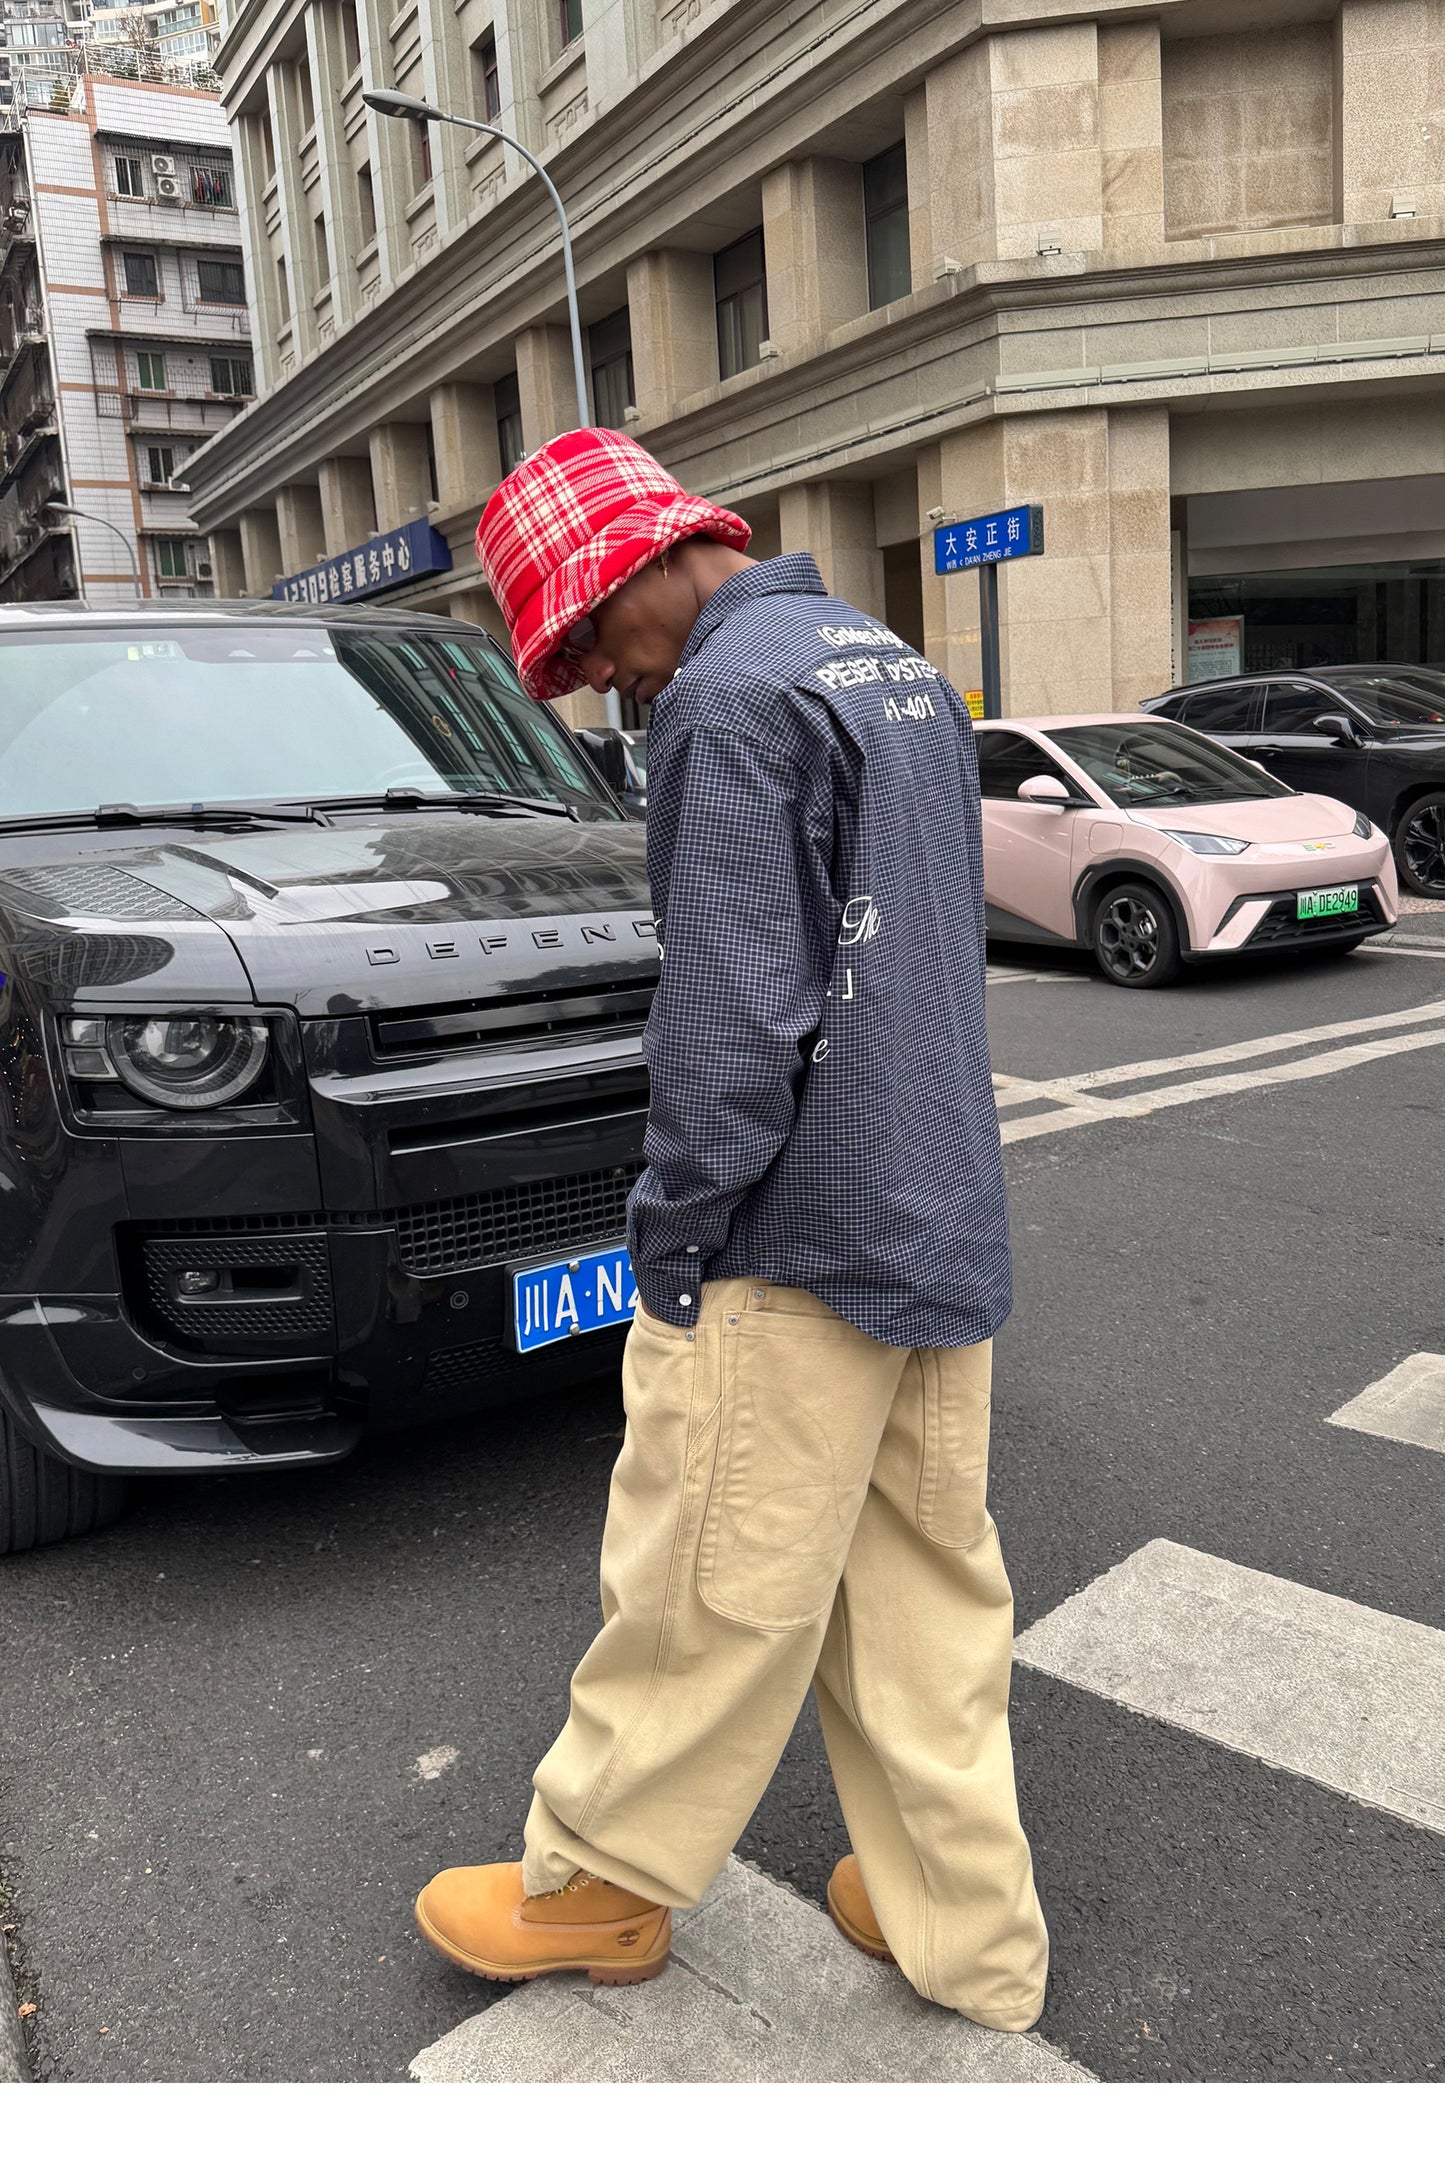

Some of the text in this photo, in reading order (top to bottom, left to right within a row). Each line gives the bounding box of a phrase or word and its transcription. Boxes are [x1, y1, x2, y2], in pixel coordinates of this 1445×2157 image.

[945, 517, 1020, 556] 大安正街
[982, 549, 1002, 562] ZHENG
[1003, 546, 1012, 557] JIE
[1318, 889, 1357, 913] DE2949
